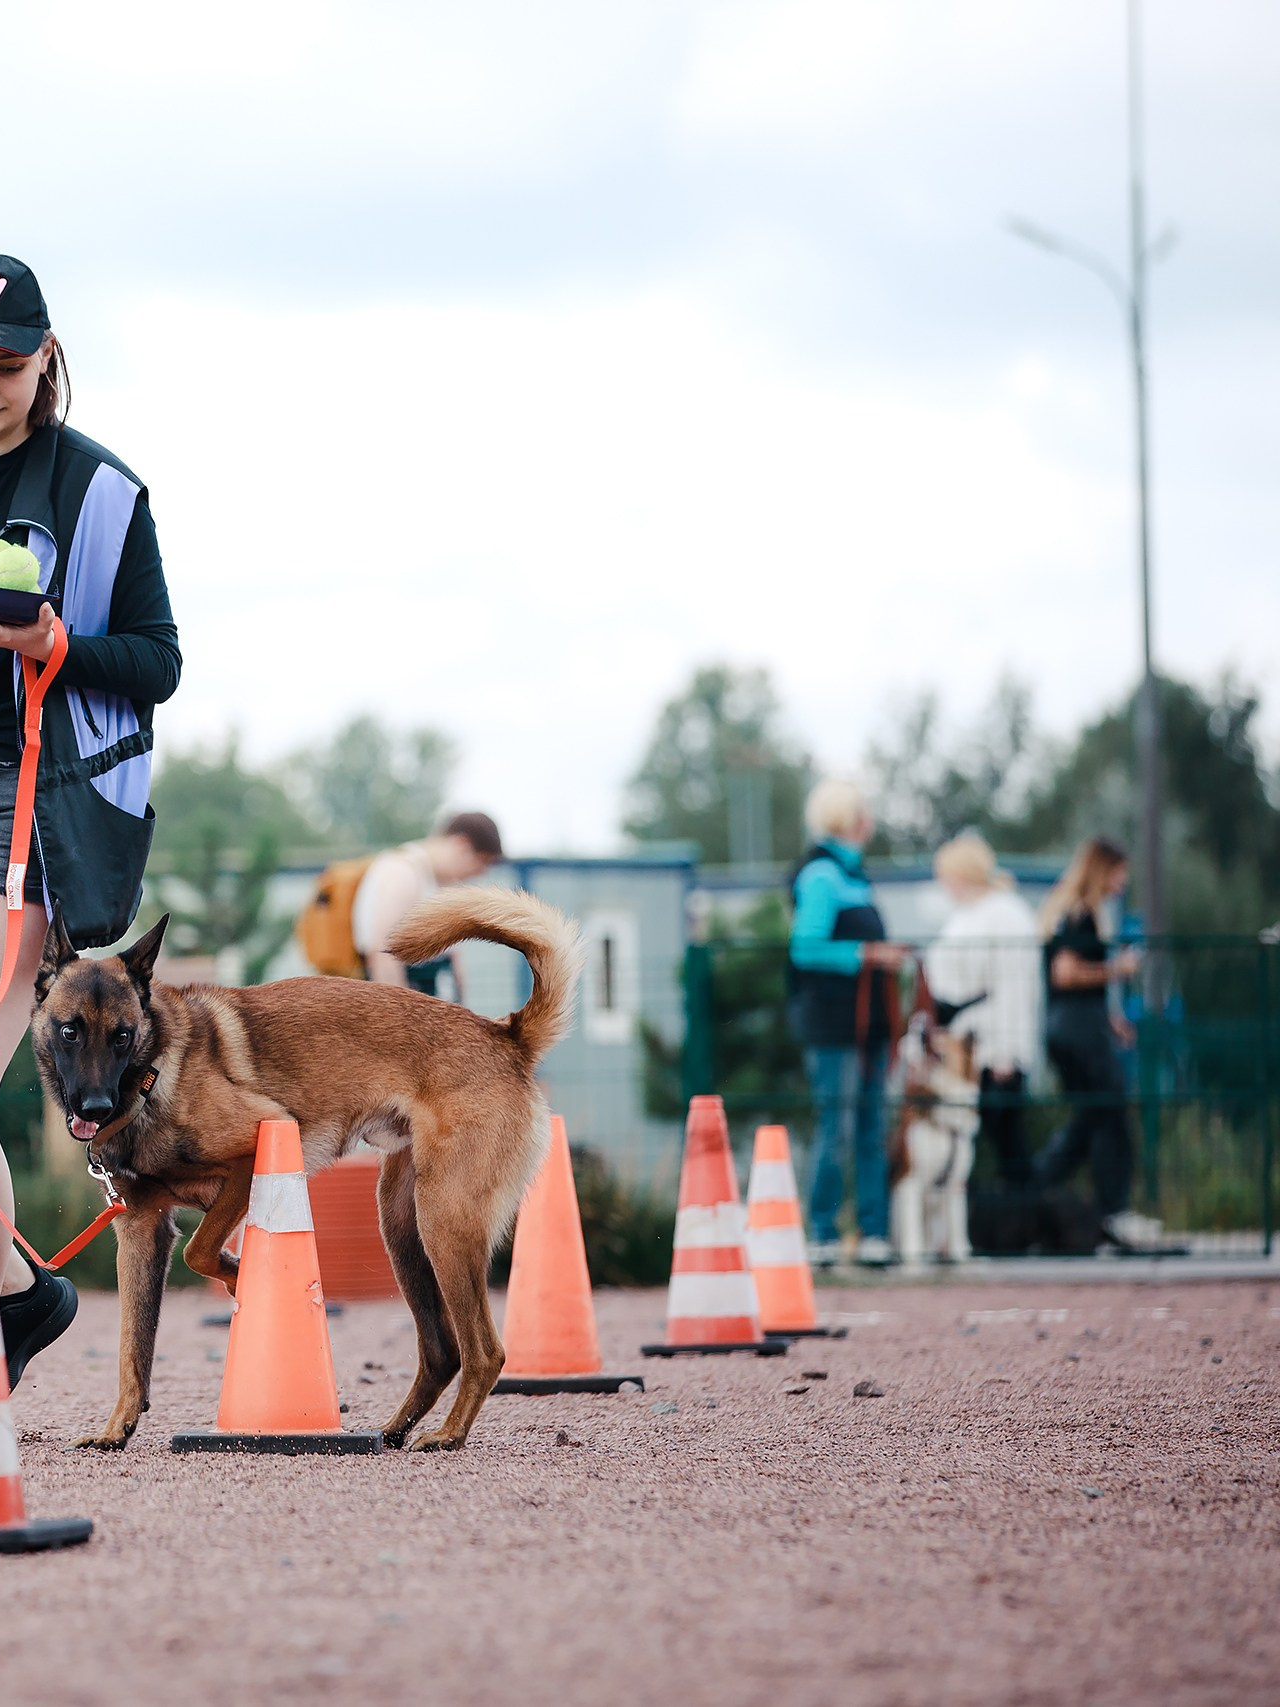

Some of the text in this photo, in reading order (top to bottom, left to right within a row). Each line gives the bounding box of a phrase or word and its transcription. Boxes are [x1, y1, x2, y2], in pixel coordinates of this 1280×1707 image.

[7, 864, 18, 907] ROYAL CANIN
[143, 1073, 156, 1091] DOG
